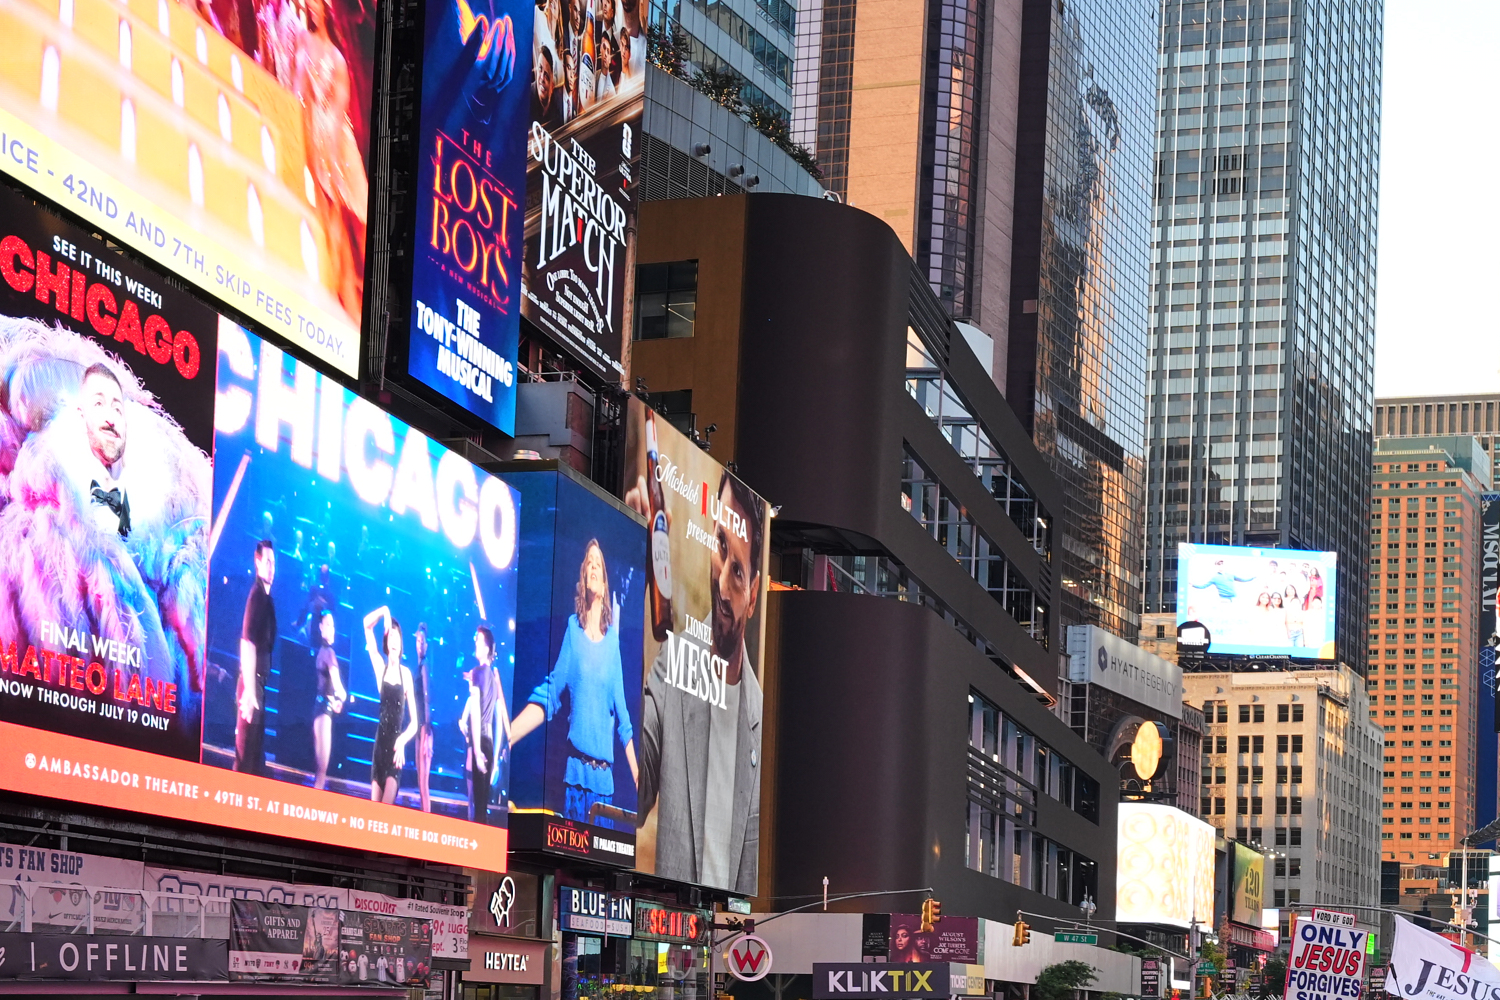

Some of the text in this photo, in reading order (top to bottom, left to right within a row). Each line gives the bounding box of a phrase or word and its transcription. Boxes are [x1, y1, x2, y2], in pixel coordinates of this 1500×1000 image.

[461, 128, 493, 168] THE
[571, 137, 597, 176] THE
[431, 135, 518, 247] LOST
[531, 121, 627, 247] SUPERIOR
[63, 174, 118, 220] 42ND
[125, 211, 166, 249] AND
[173, 237, 209, 277] 7TH.
[215, 266, 251, 300] SKIP
[256, 291, 292, 327] FEES
[297, 315, 345, 359] TODAY.
[430, 195, 511, 305] BOYS
[537, 169, 617, 333] MATCH
[52, 234, 163, 310] SEE IT THIS WEEK!
[0, 234, 201, 380] CHICAGO
[456, 298, 481, 339] THE
[416, 300, 513, 388] TONY-WINNING
[436, 344, 493, 403] MUSICAL
[214, 314, 516, 569] CHICAGO
[655, 453, 748, 543] Michelob ULTRA
[686, 518, 720, 554] presents
[40, 619, 141, 668] FINAL WEEK!
[685, 613, 714, 646] LIONEL
[0, 637, 177, 714] MATTEO LANE
[664, 629, 729, 710] MESSI
[1110, 656, 1177, 698] HYATT REGENCY
[0, 677, 170, 731] NOW THROUGH JULY 19 ONLY
[38, 755, 469, 849] AMBASSADOR THEATRE 49TH ST. AT BROADWAY NO FEES AT THE BOX OFFICE
[547, 824, 590, 854] LOST BOYS
[599, 837, 635, 857] PALACE THEATRE
[19, 848, 84, 876] FAN SHOP
[407, 902, 465, 919] #1 Rated Souvenir Shop
[571, 889, 632, 920] BLUE FIN
[1244, 897, 1260, 914] YEARS
[1316, 911, 1354, 926] WORD OF GOD
[264, 915, 301, 929] GIFTS AND
[267, 928, 299, 940] APPAREL
[363, 917, 407, 937] SPORTS
[369, 933, 382, 941] FAN
[383, 934, 401, 943] SHOP
[571, 917, 631, 933] SEAFOOD SUSHI
[1301, 924, 1364, 949] ONLY
[59, 942, 188, 972] OFFLINE
[732, 949, 766, 972] W
[1294, 943, 1362, 976] JESUS
[828, 970, 934, 993] KLIKTIX
[950, 974, 985, 990] TICKET CENTER
[1288, 970, 1360, 998] FORGIVES
[1425, 989, 1436, 998] THE
